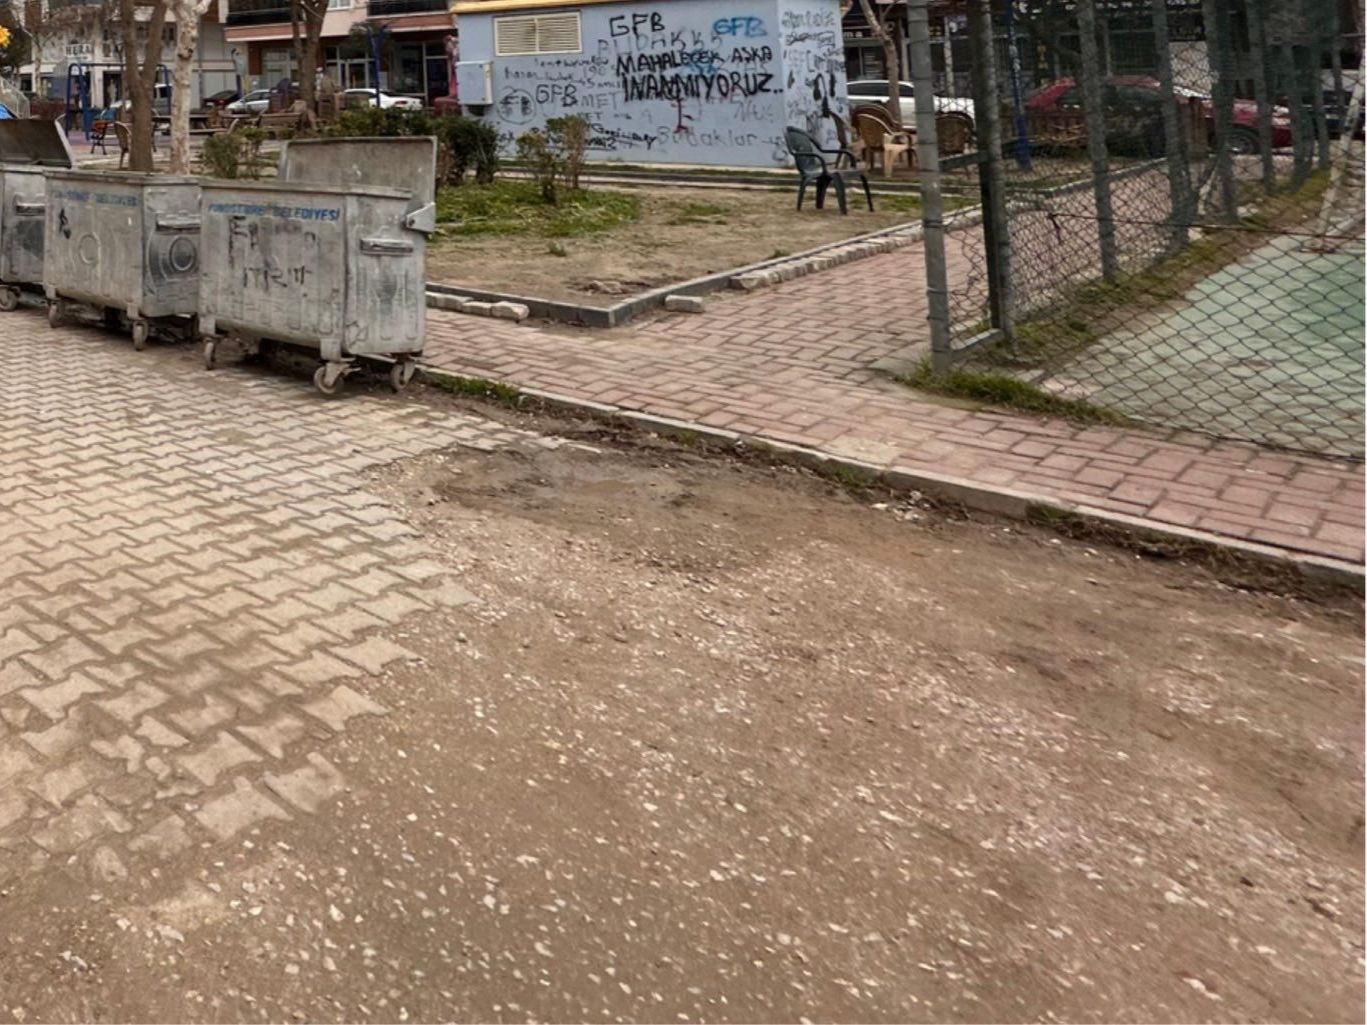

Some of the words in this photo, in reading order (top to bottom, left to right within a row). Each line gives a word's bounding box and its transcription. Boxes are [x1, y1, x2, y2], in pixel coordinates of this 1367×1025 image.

[609, 12, 665, 39] GFB
[713, 16, 768, 37] GFB
[731, 45, 772, 63] AŞKA
[535, 84, 578, 108] GFB
